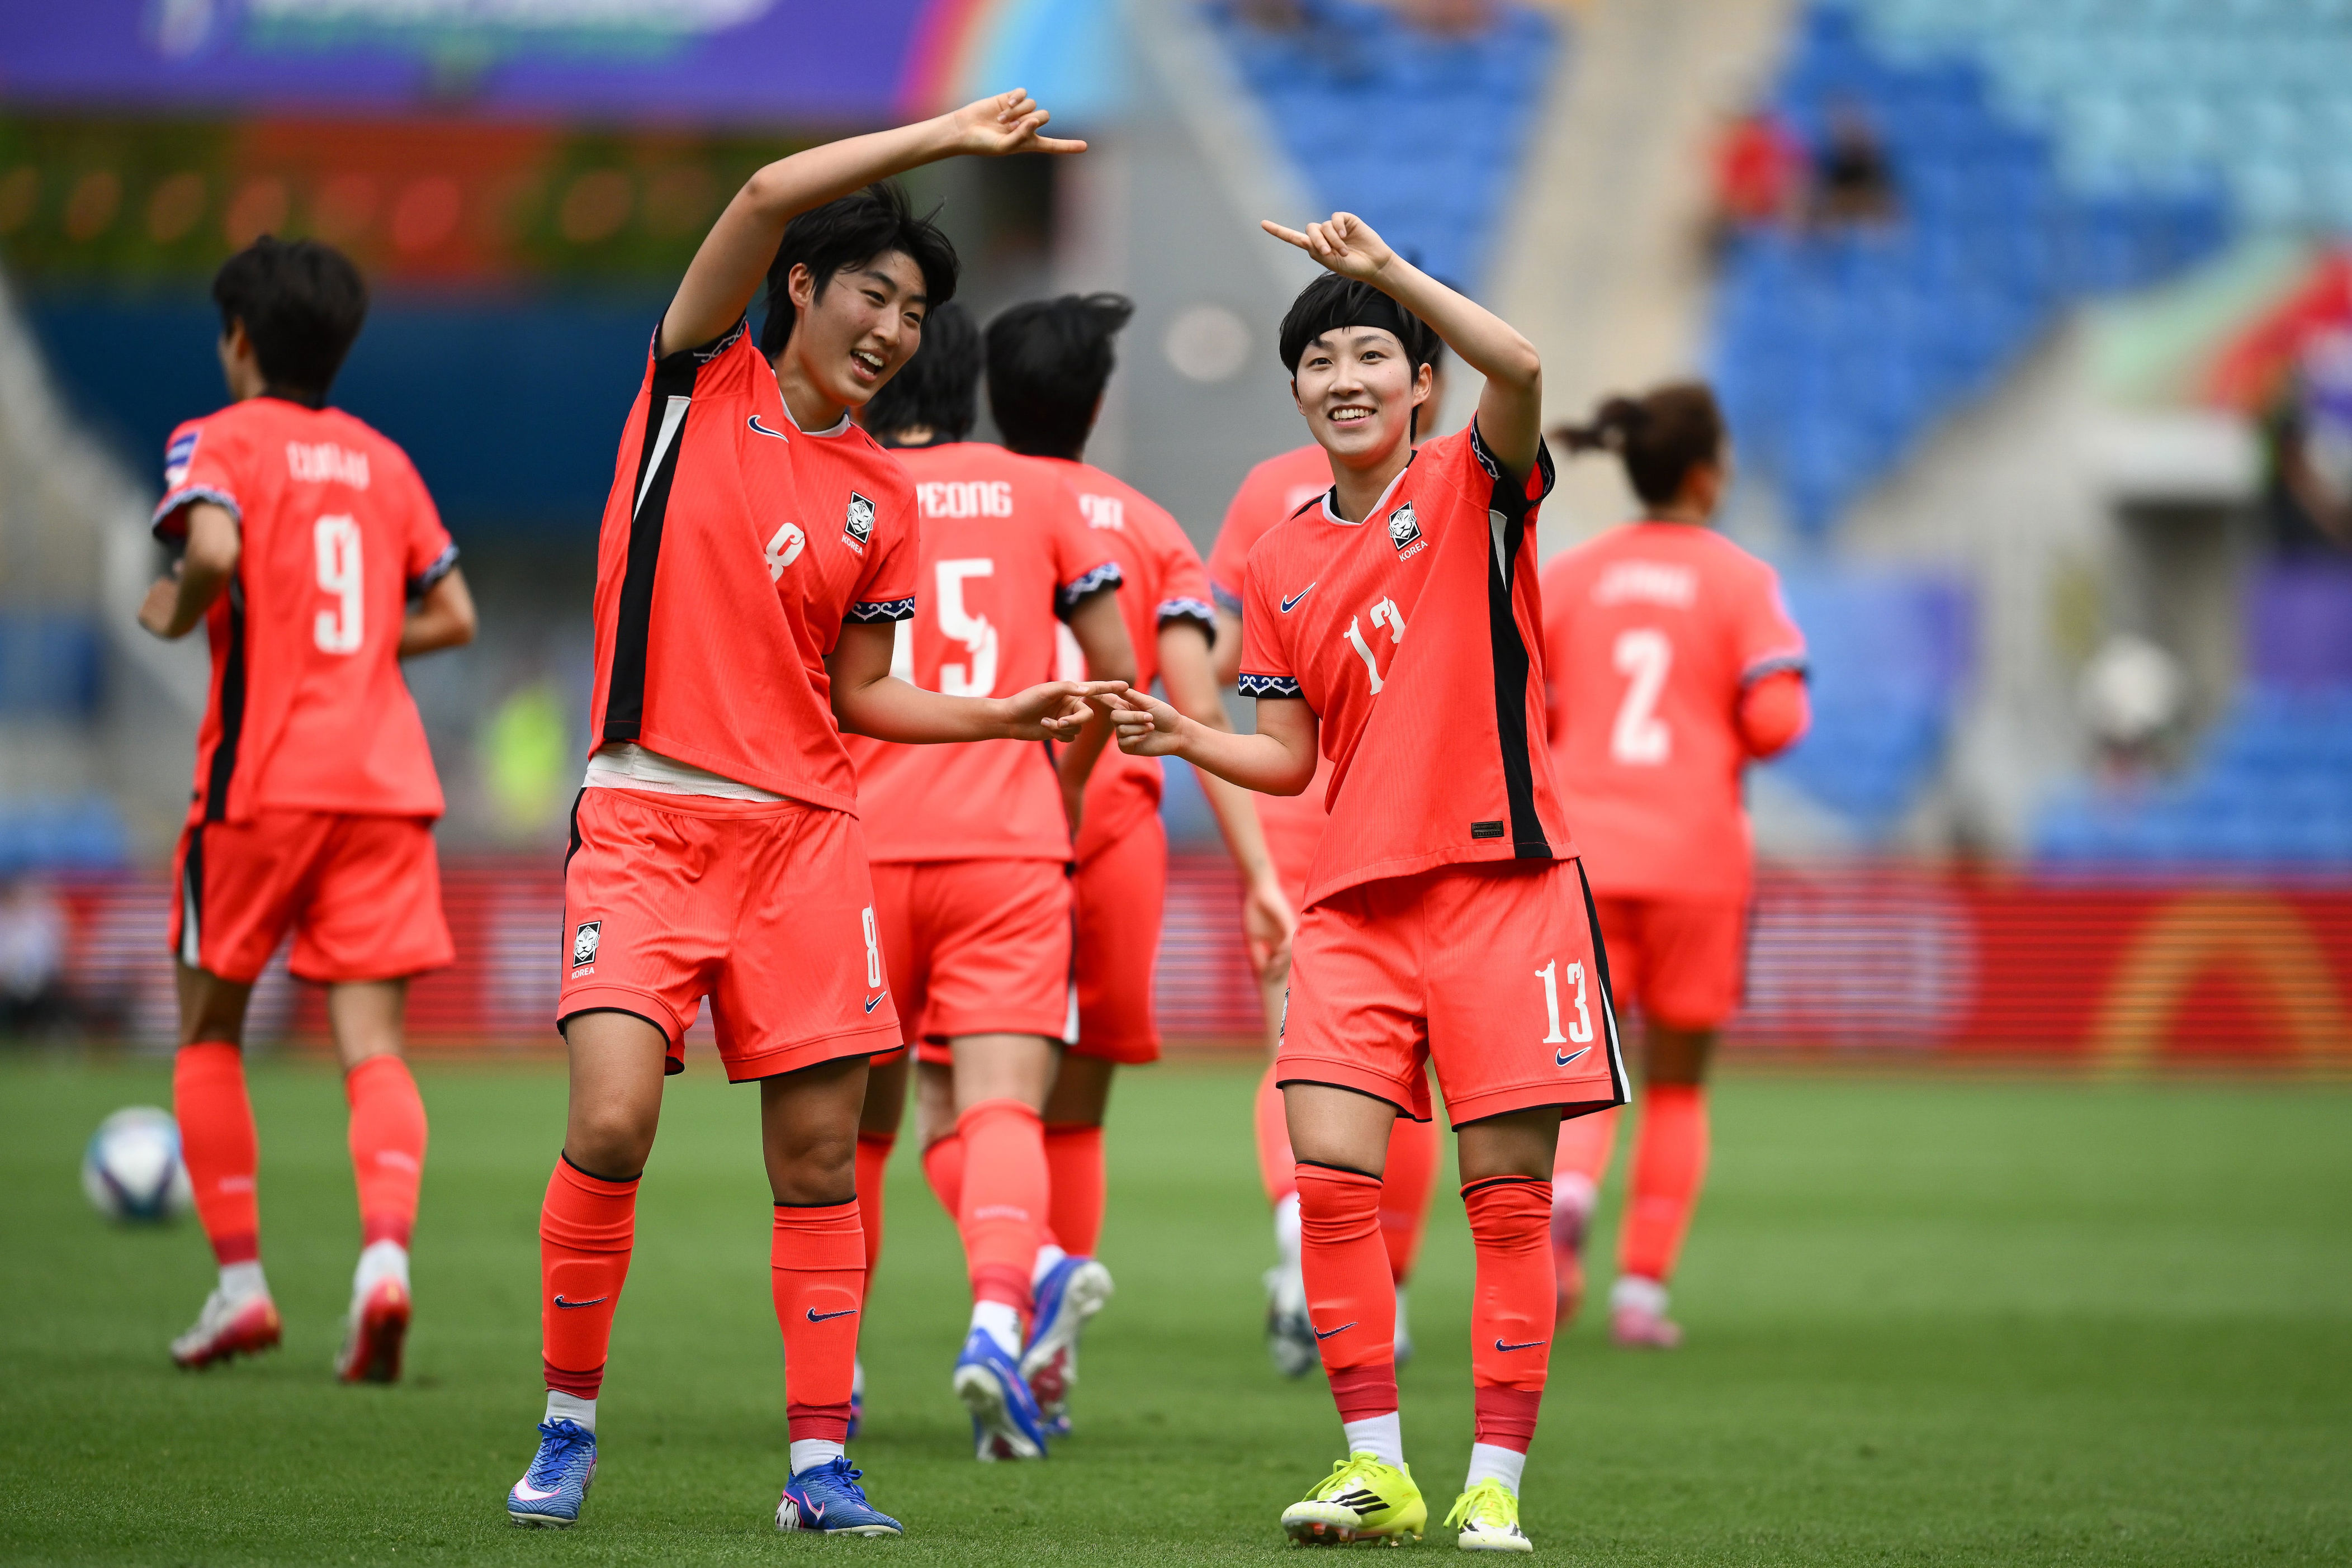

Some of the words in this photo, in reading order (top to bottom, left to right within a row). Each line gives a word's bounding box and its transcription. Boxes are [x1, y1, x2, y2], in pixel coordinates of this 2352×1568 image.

[764, 522, 805, 584] 8
[841, 534, 863, 556] KOREA
[1398, 540, 1428, 562] KOREA
[314, 514, 365, 655] 9
[1611, 628, 1672, 764] 2
[571, 967, 595, 980] KOREA
[862, 902, 881, 988] 8
[1535, 958, 1593, 1043] 13
